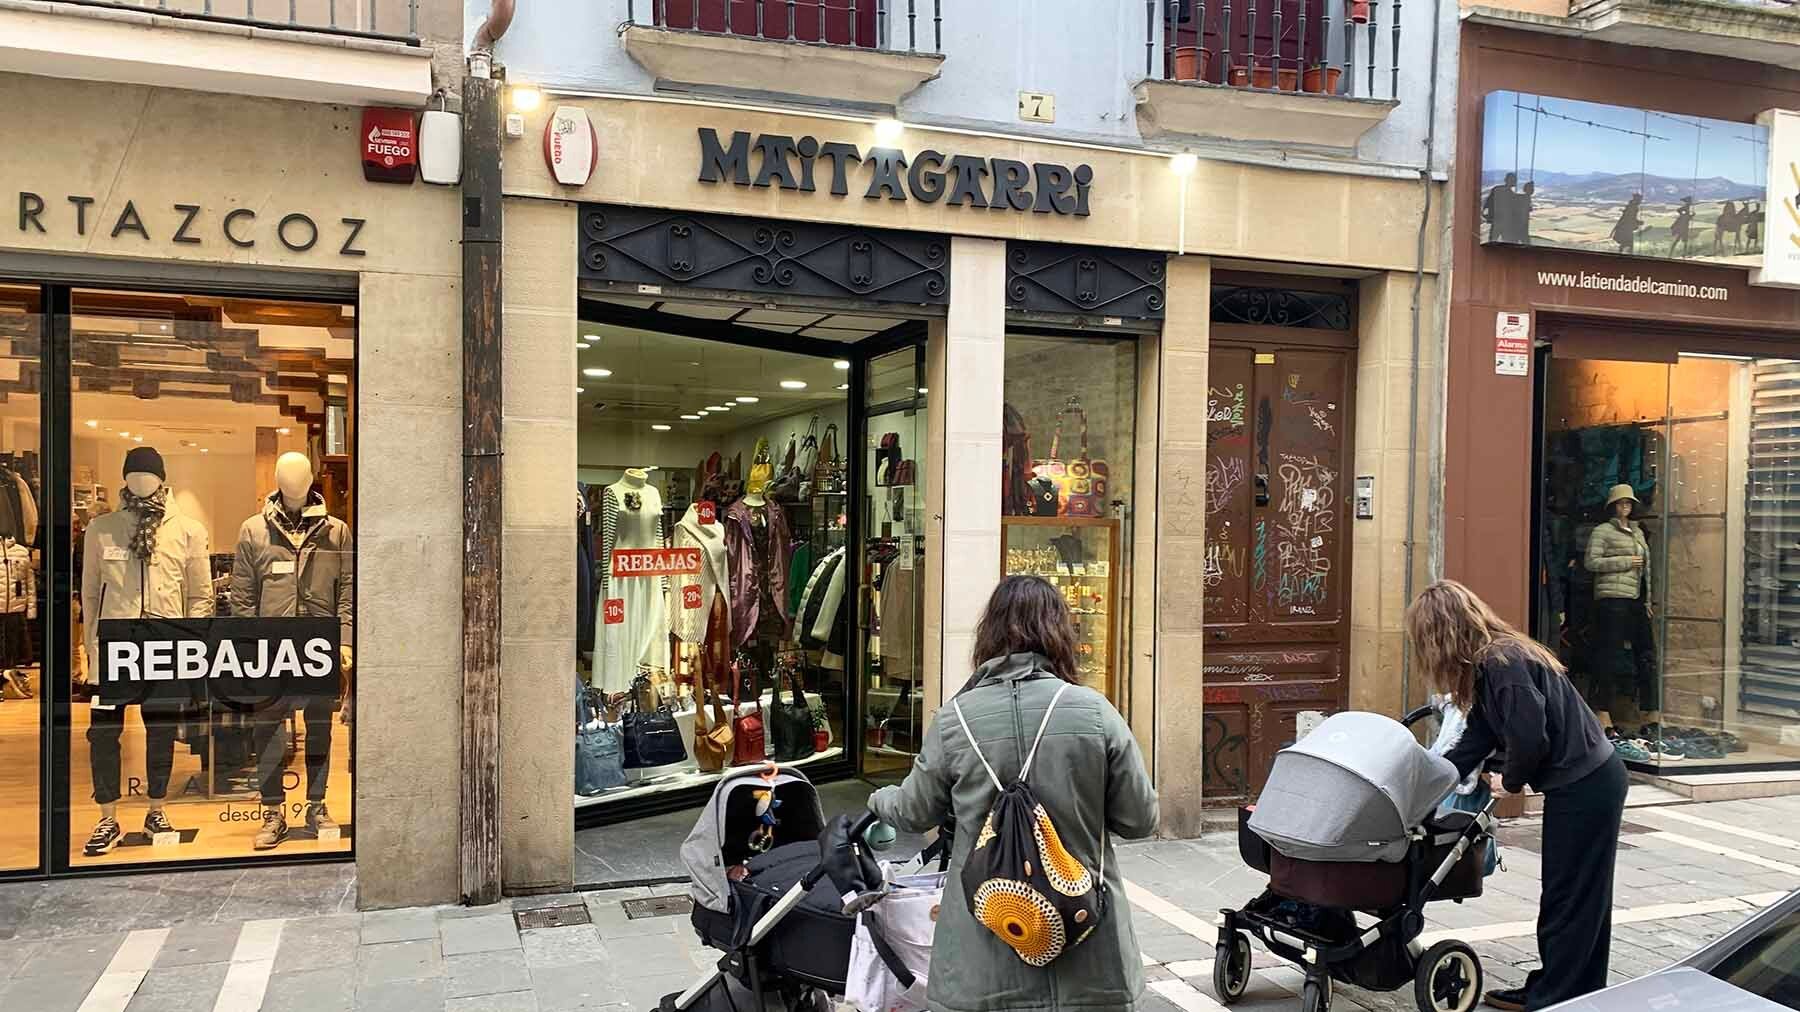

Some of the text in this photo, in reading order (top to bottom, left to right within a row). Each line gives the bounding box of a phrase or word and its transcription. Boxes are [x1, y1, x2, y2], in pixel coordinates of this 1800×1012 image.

[1031, 95, 1044, 117] 7
[367, 143, 410, 157] FUEGO
[554, 131, 562, 164] FUEGO
[19, 191, 367, 256] RTAZCOZ
[1537, 271, 1728, 300] www.latiendadelcamino.com
[617, 553, 697, 571] REBAJAS
[108, 638, 333, 681] REBAJAS
